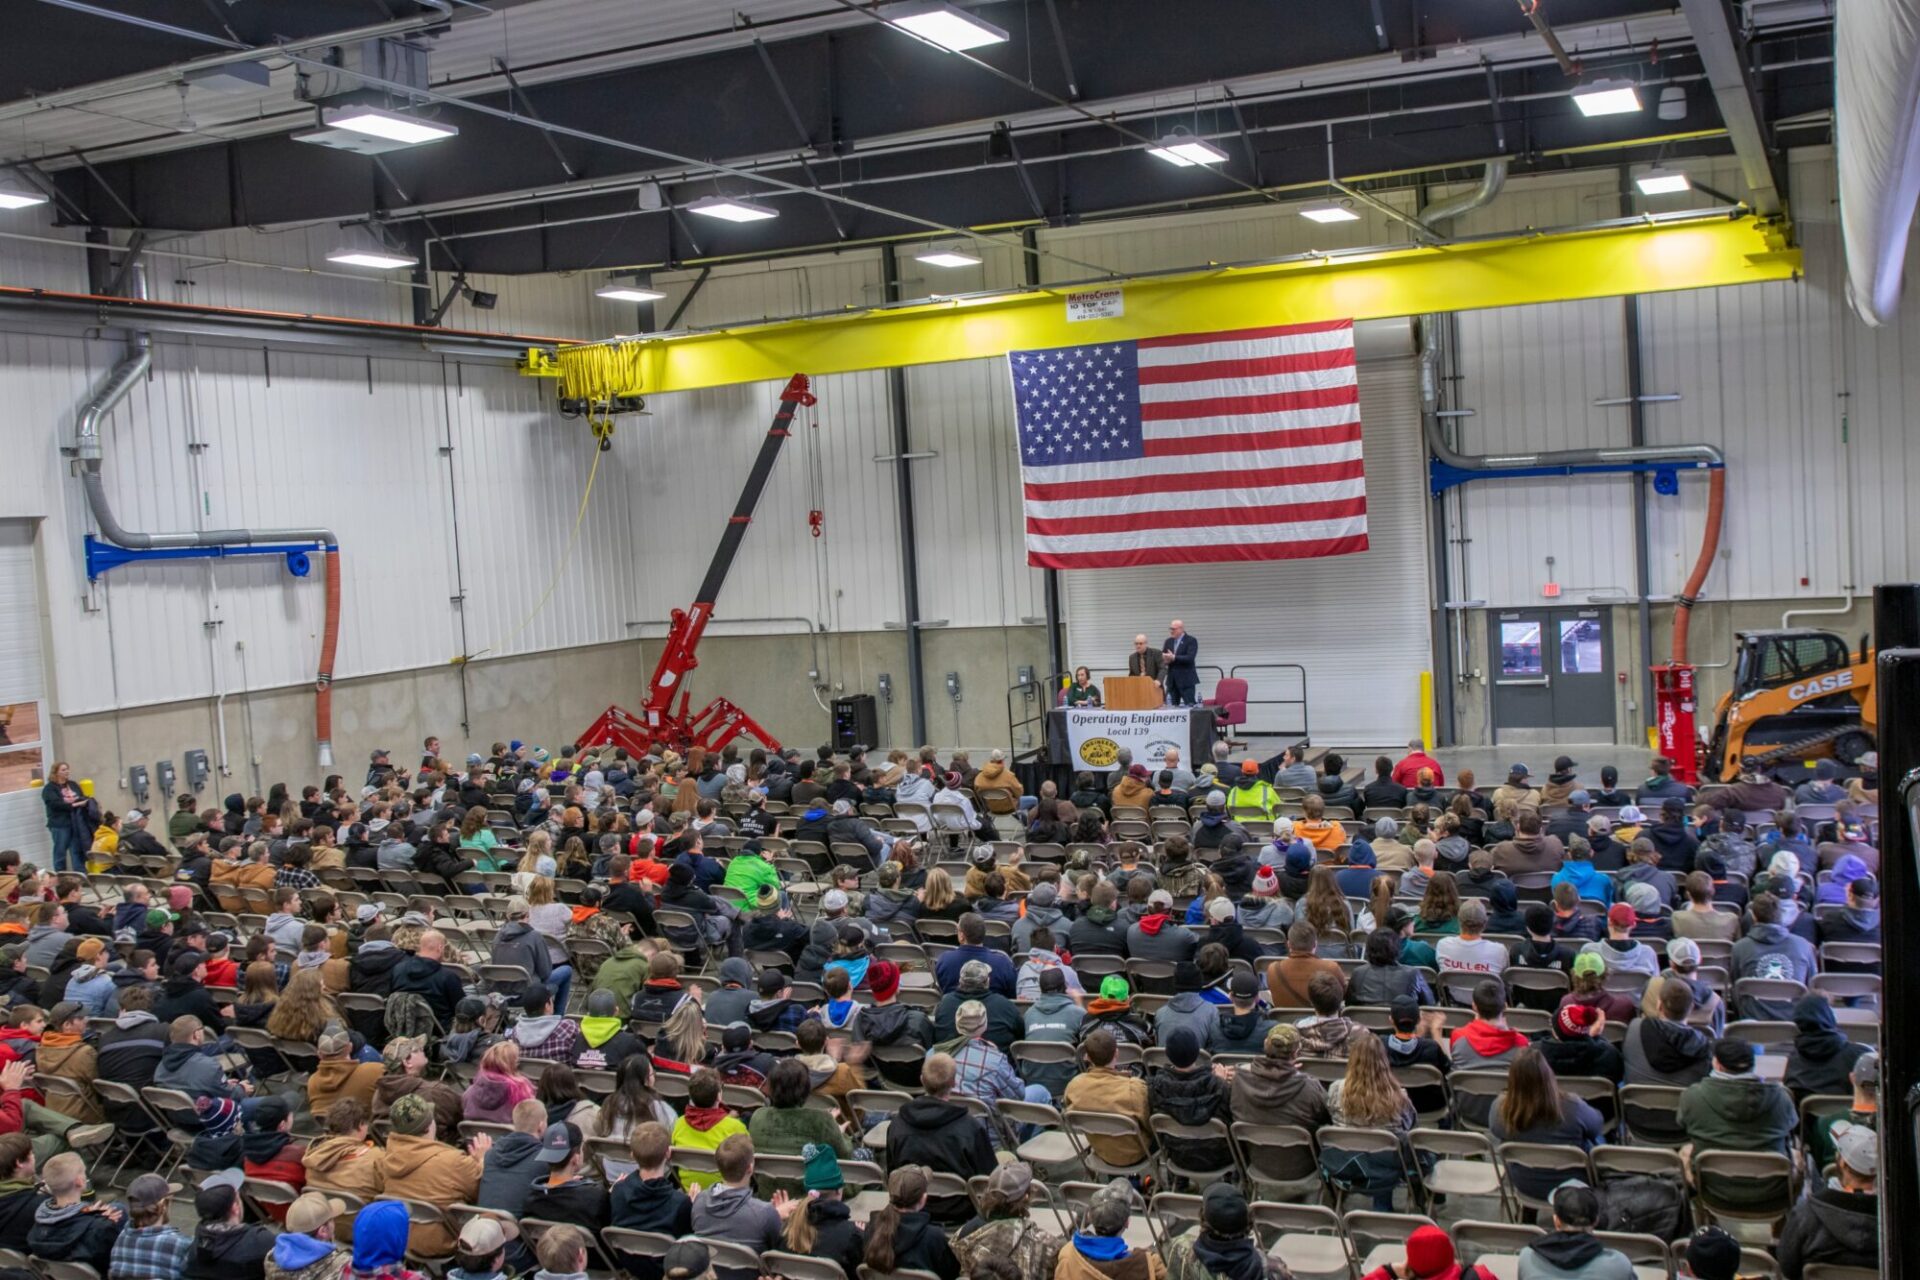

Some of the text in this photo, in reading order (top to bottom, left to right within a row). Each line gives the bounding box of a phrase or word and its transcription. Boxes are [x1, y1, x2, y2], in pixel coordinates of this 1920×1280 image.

[1068, 290, 1120, 302] MetroCrane
[1788, 671, 1853, 700] CASE
[1072, 713, 1187, 726] Operating Engineers
[1107, 727, 1149, 736] Local 139
[1443, 958, 1490, 972] CULLEN
